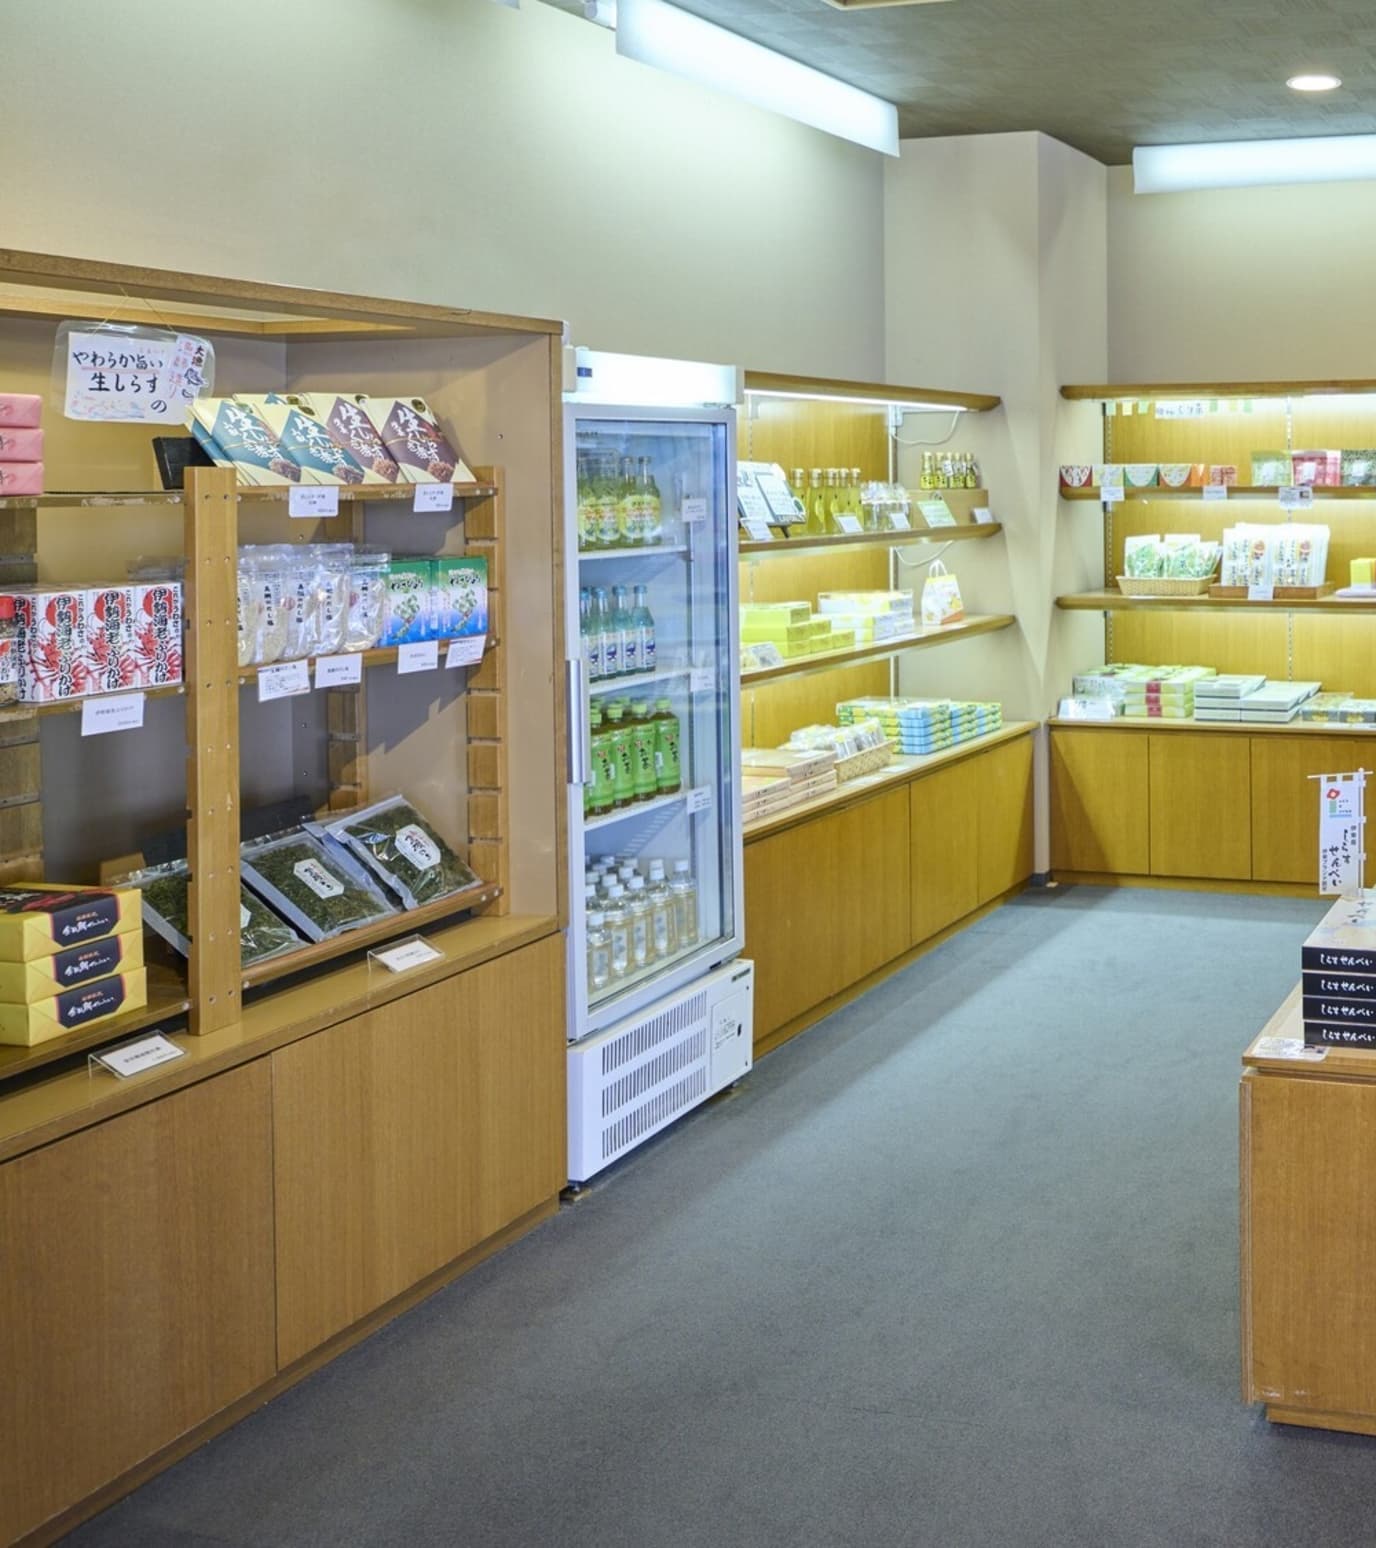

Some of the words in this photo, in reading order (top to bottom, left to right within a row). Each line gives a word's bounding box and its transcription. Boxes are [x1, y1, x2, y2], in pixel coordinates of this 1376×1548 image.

[73, 351, 164, 371] やわらか旨い
[88, 372, 158, 393] 生しらす
[150, 399, 168, 413] の
[105, 590, 120, 689] 伊勢海老ふりかけ
[153, 588, 168, 683] 伊勢海老ふりかけ
[56, 596, 72, 697] 伊勢海老ふりかけ
[1341, 828, 1351, 864] しらす
[1328, 845, 1342, 887] せんべい
[1320, 953, 1374, 967] しらすせんべい
[1320, 978, 1374, 993] しらすせんべい
[1320, 1003, 1374, 1017] しらすせんべい
[1322, 1028, 1376, 1043] しらすせんべい
